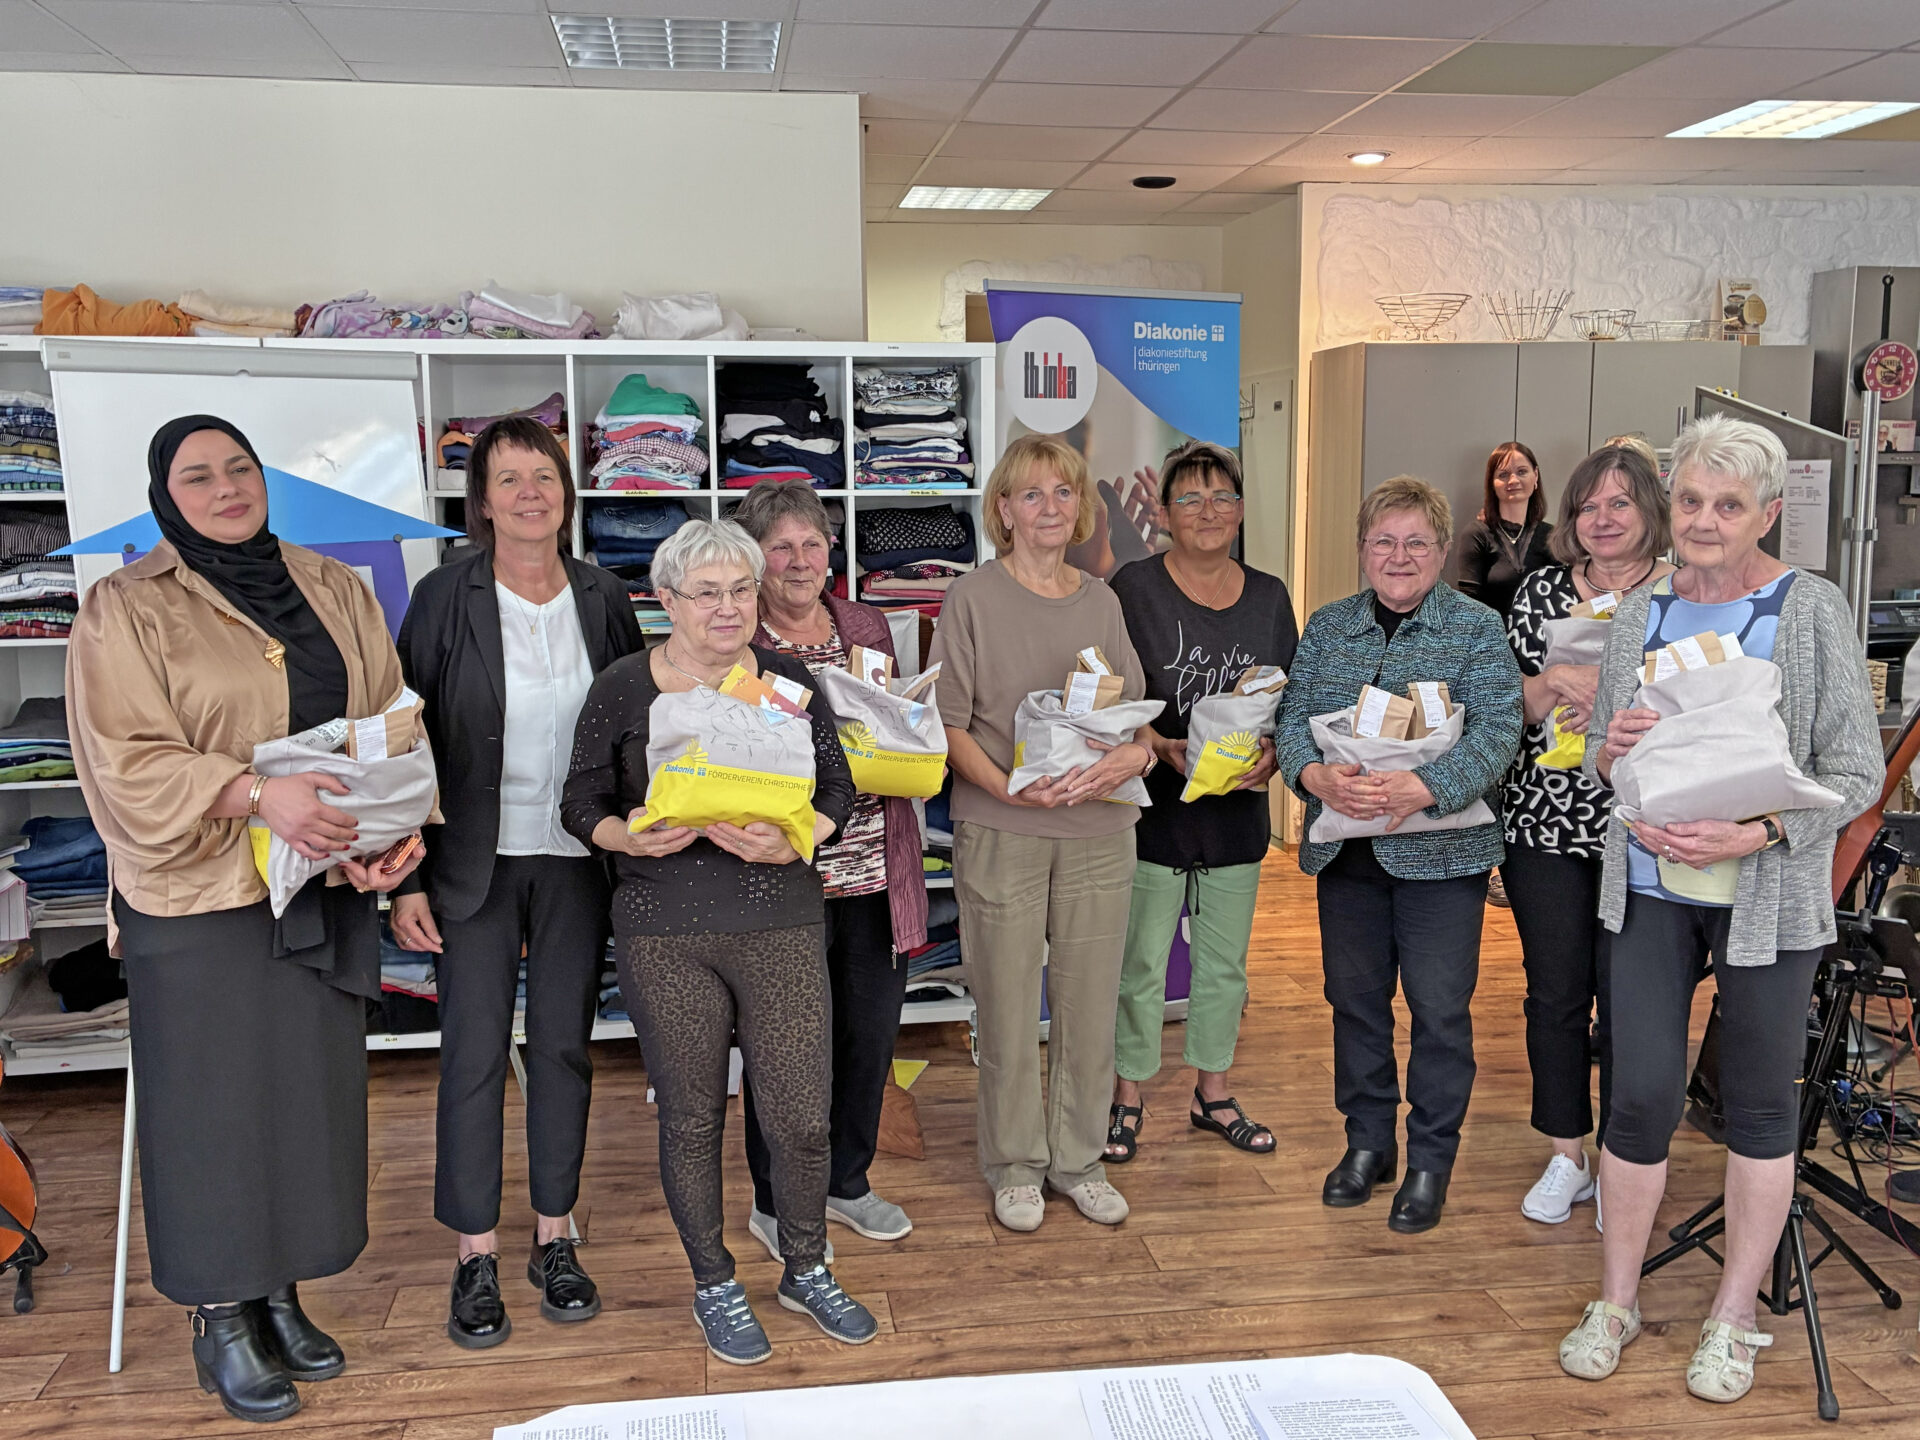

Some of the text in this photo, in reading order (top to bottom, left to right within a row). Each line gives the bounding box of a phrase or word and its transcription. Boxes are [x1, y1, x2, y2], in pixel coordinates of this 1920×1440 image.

[1134, 321, 1207, 341] Diakonie
[1138, 346, 1207, 361] diakoniestiftung
[1138, 360, 1181, 374] thüringen
[1163, 620, 1211, 670] La
[842, 744, 864, 757] konie
[1216, 747, 1250, 762] Diakonie
[664, 763, 695, 775] Diakonie
[708, 769, 762, 785] FÖRDERVEREIN
